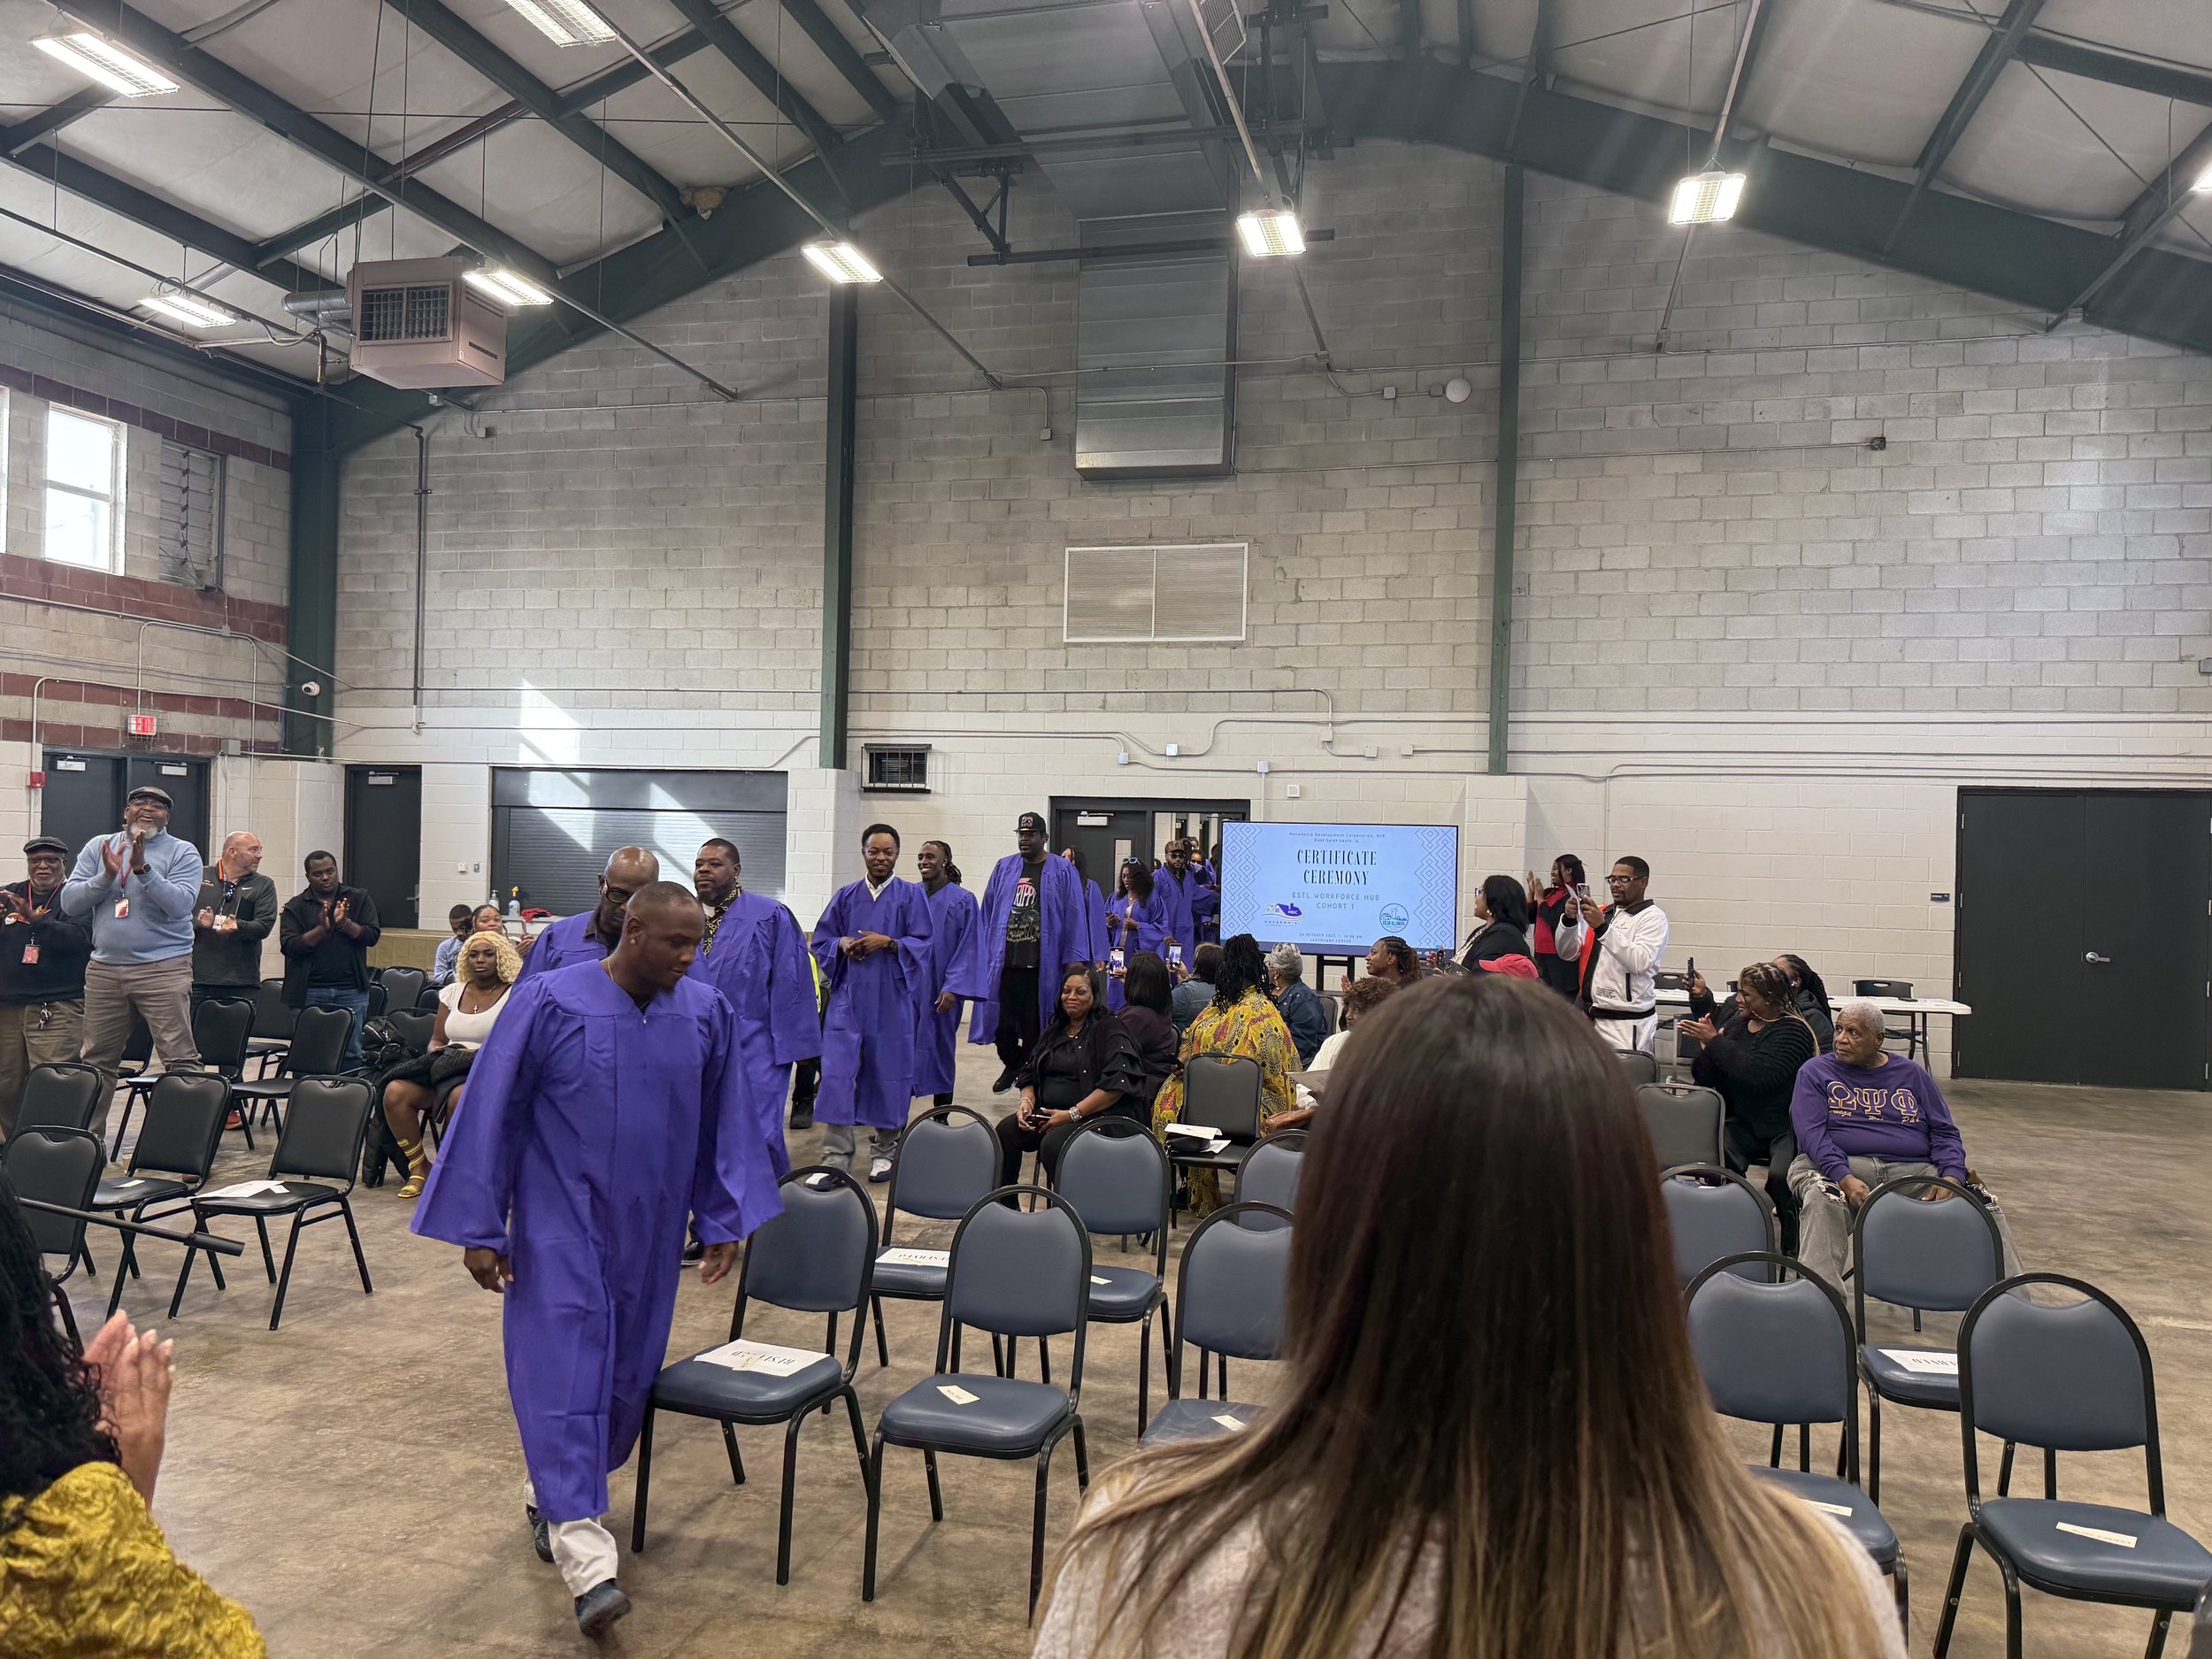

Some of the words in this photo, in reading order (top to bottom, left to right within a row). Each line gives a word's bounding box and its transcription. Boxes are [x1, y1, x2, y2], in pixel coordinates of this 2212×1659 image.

[1297, 849, 1377, 866] CERTIFICATE
[1303, 869, 1370, 886] CEREMONY
[1314, 892, 1360, 901] WORKFORCE
